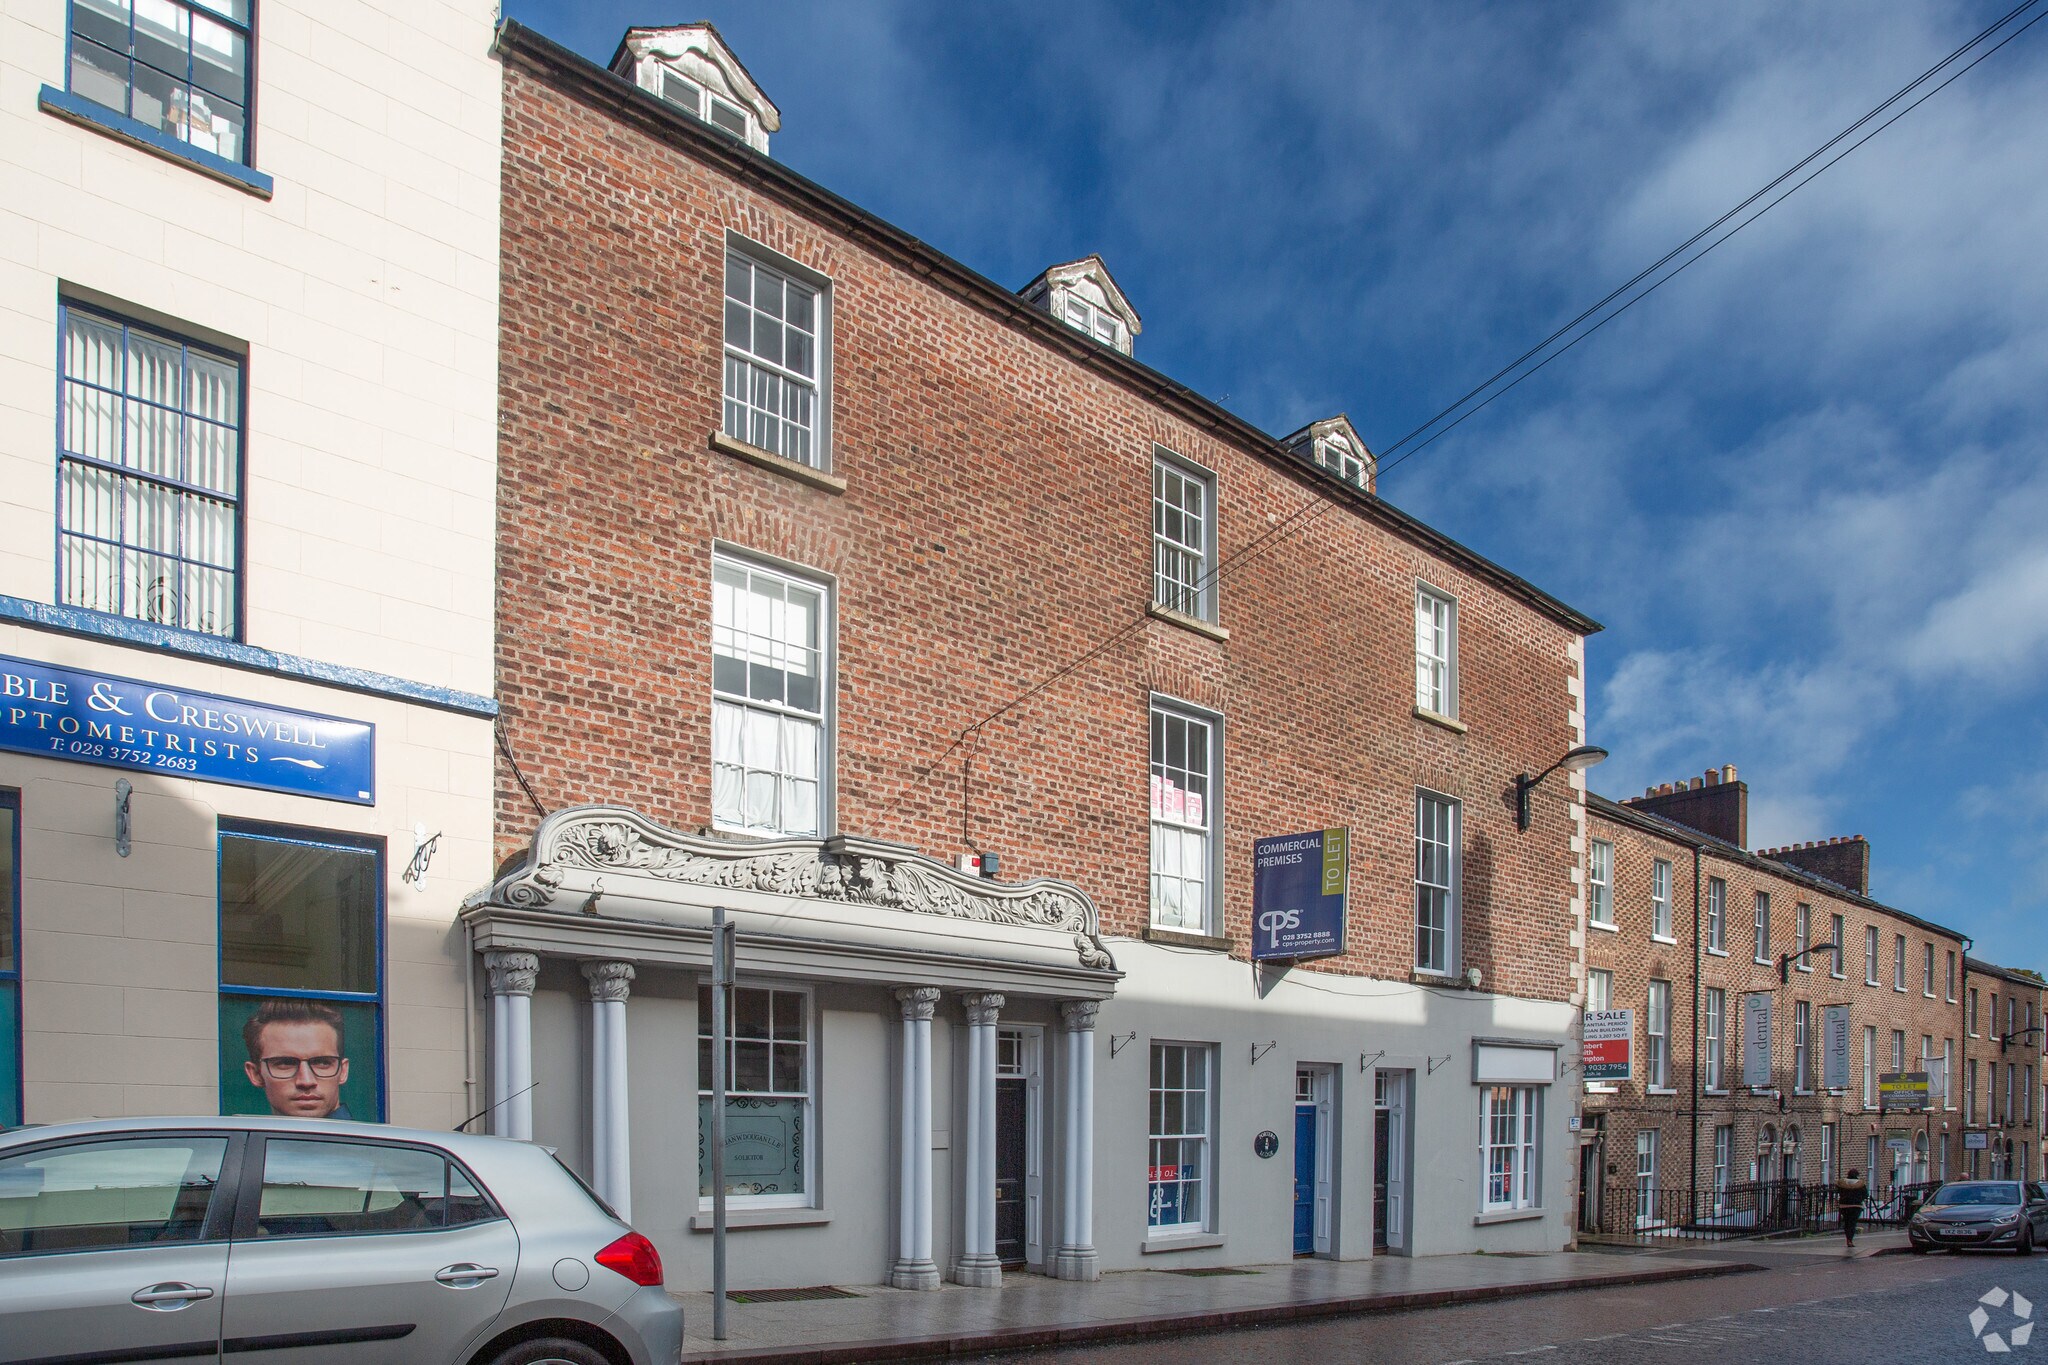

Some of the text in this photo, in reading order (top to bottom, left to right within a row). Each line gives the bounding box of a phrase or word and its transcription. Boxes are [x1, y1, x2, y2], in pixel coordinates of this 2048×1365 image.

[0, 672, 69, 706] BLE
[87, 682, 134, 716] &
[0, 707, 259, 763] PTOMETRISTS
[50, 736, 197, 771] T: 028 3752 2683
[1257, 838, 1321, 855] COMMERCIAL
[1257, 853, 1303, 868] PREMISES
[1326, 835, 1341, 890] TO LET
[1282, 937, 1335, 947] cps-property.com
[1296, 932, 1312, 940] 3752
[1585, 1011, 1626, 1021] R SALE
[743, 1133, 768, 1142] DOUGAN
